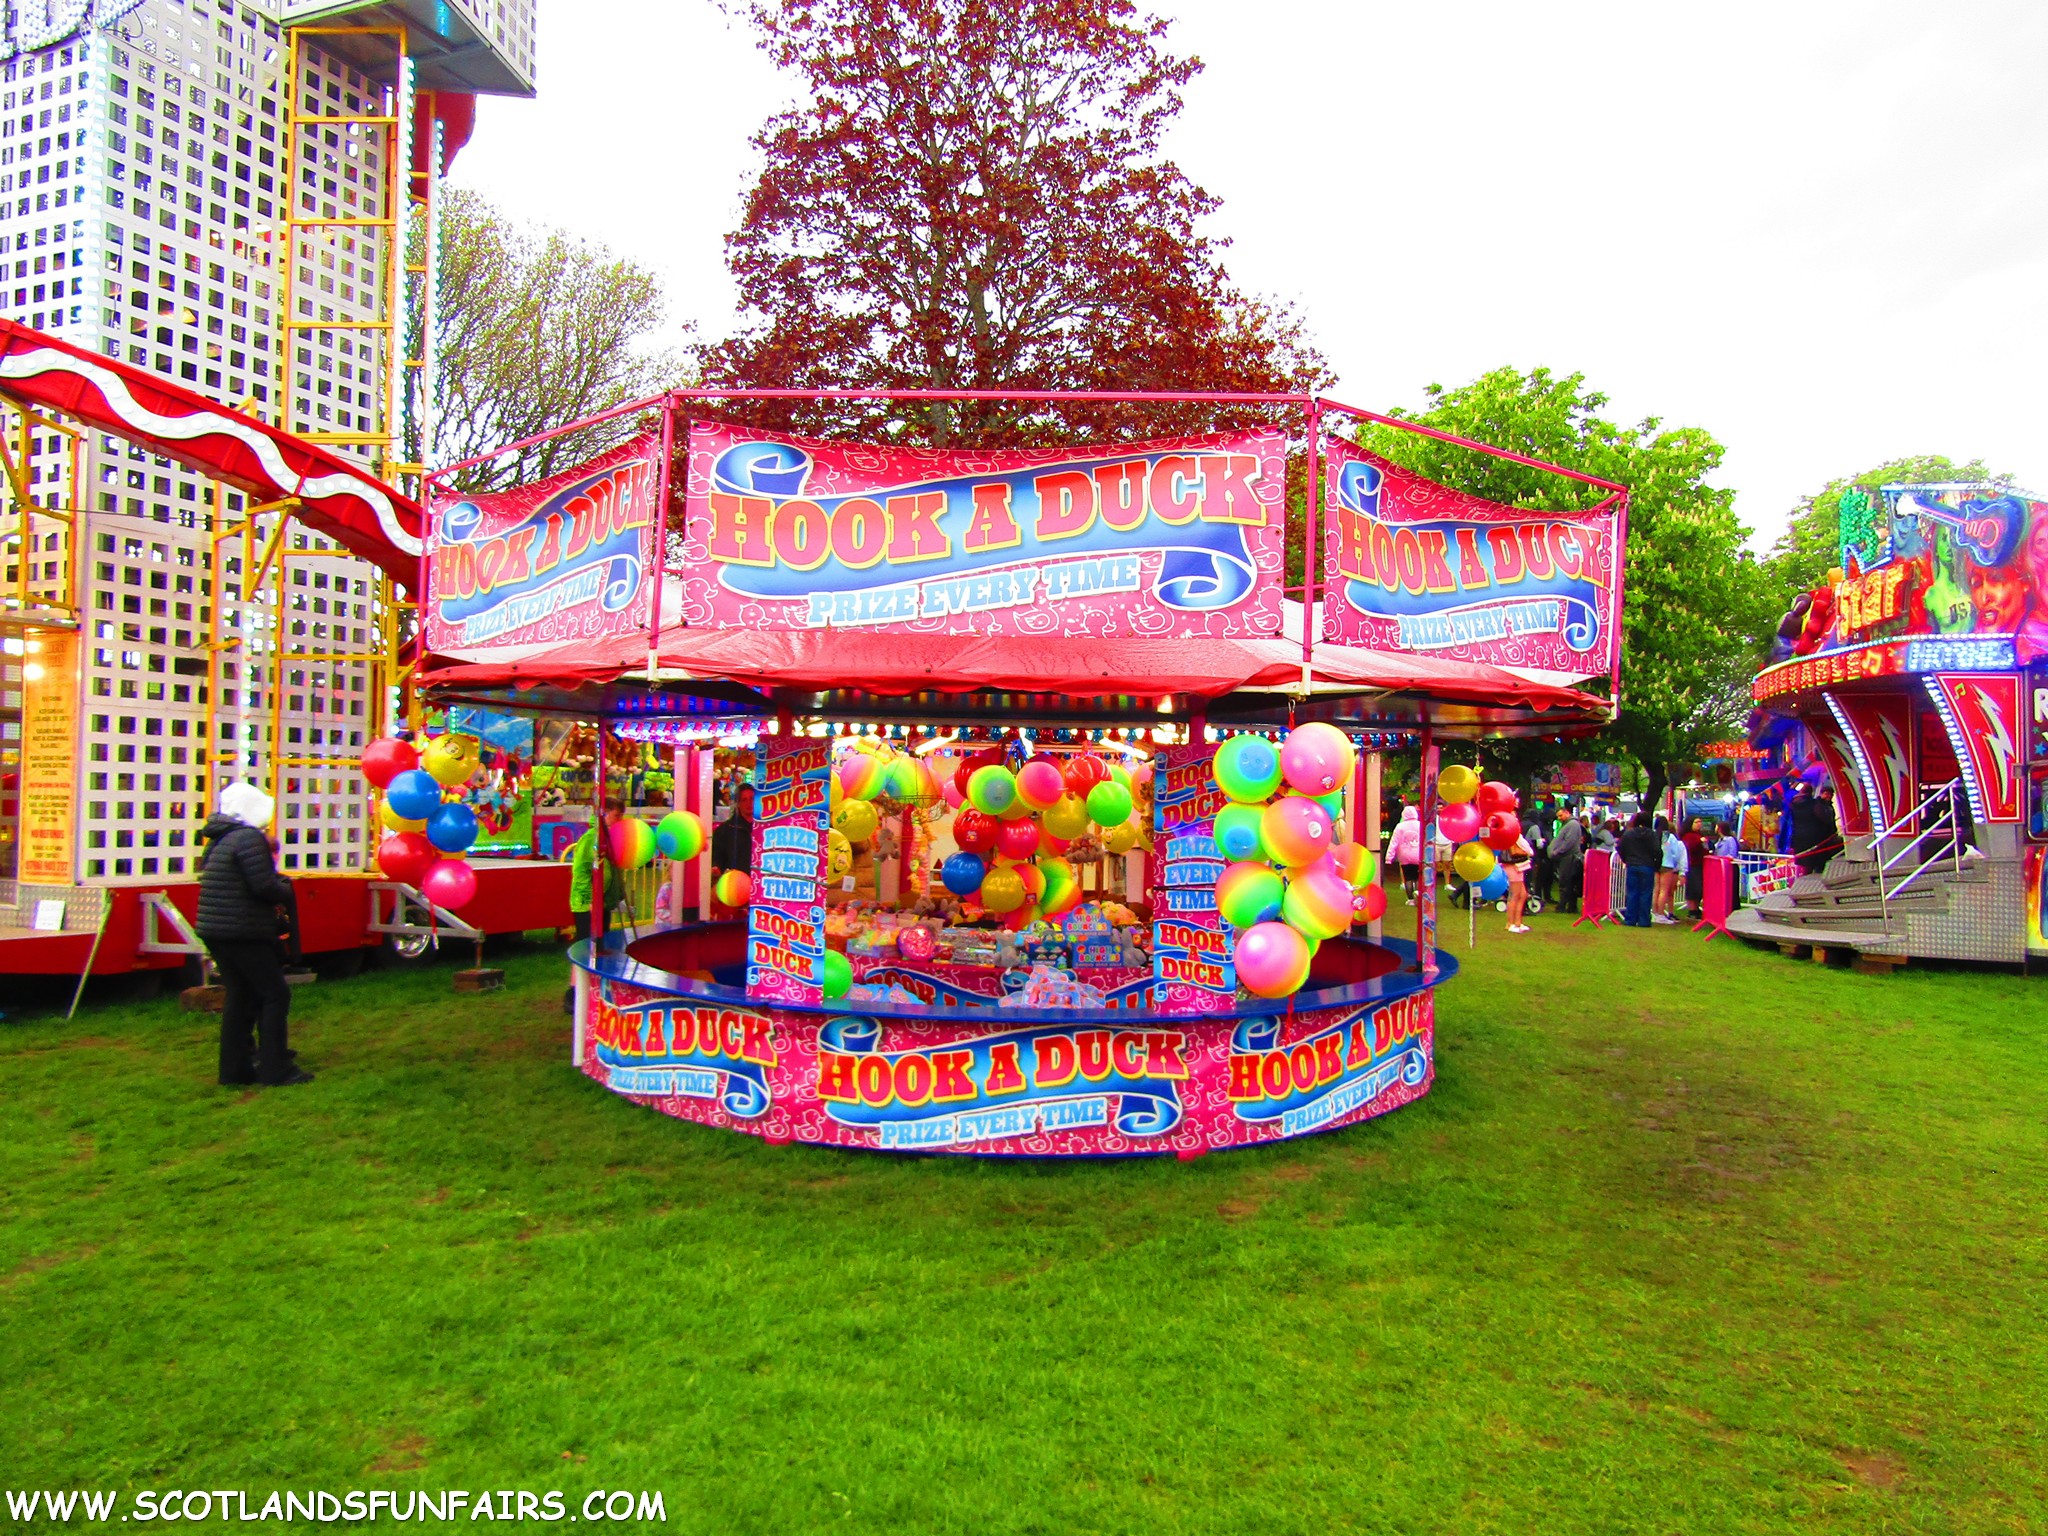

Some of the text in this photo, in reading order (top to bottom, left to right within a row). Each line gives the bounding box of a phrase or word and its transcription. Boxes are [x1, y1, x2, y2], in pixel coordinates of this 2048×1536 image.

[708, 452, 1266, 570] HOOK A DUCK
[437, 462, 650, 601] HOOK A DUCK
[1338, 507, 1608, 593] HOOK A DUCK
[464, 574, 601, 644] PRIZE EVERY TIME
[807, 556, 1141, 630] PRIZE EVERY TIME
[1397, 600, 1561, 652] PRIZE EVERY TIME
[765, 746, 828, 784] HOOK
[791, 768, 803, 788] A
[1166, 758, 1214, 793] HOO
[761, 780, 825, 820] DUCK
[1195, 777, 1207, 797] A
[1162, 791, 1230, 831] DUCK
[762, 826, 819, 853] PRIZE
[761, 851, 819, 878] EVERY
[1164, 861, 1226, 887] EVERY
[761, 877, 815, 902] TIME!
[755, 908, 818, 947] HOOK
[779, 932, 792, 952] A
[1159, 923, 1227, 955] HOOK
[755, 941, 814, 980] DUCK
[1161, 956, 1226, 988] DUCK
[1187, 944, 1202, 963] A
[594, 998, 778, 1068] HOOK A DUCK
[1227, 990, 1428, 1103] HOOK A DUCK
[674, 1068, 719, 1099] TIME
[817, 1030, 1191, 1108] HOOK A DUCK
[879, 1096, 1110, 1149] PRIZE EVERY TIME
[1282, 1095, 1334, 1136] PRIZE
[1330, 1072, 1378, 1118] EVERY
